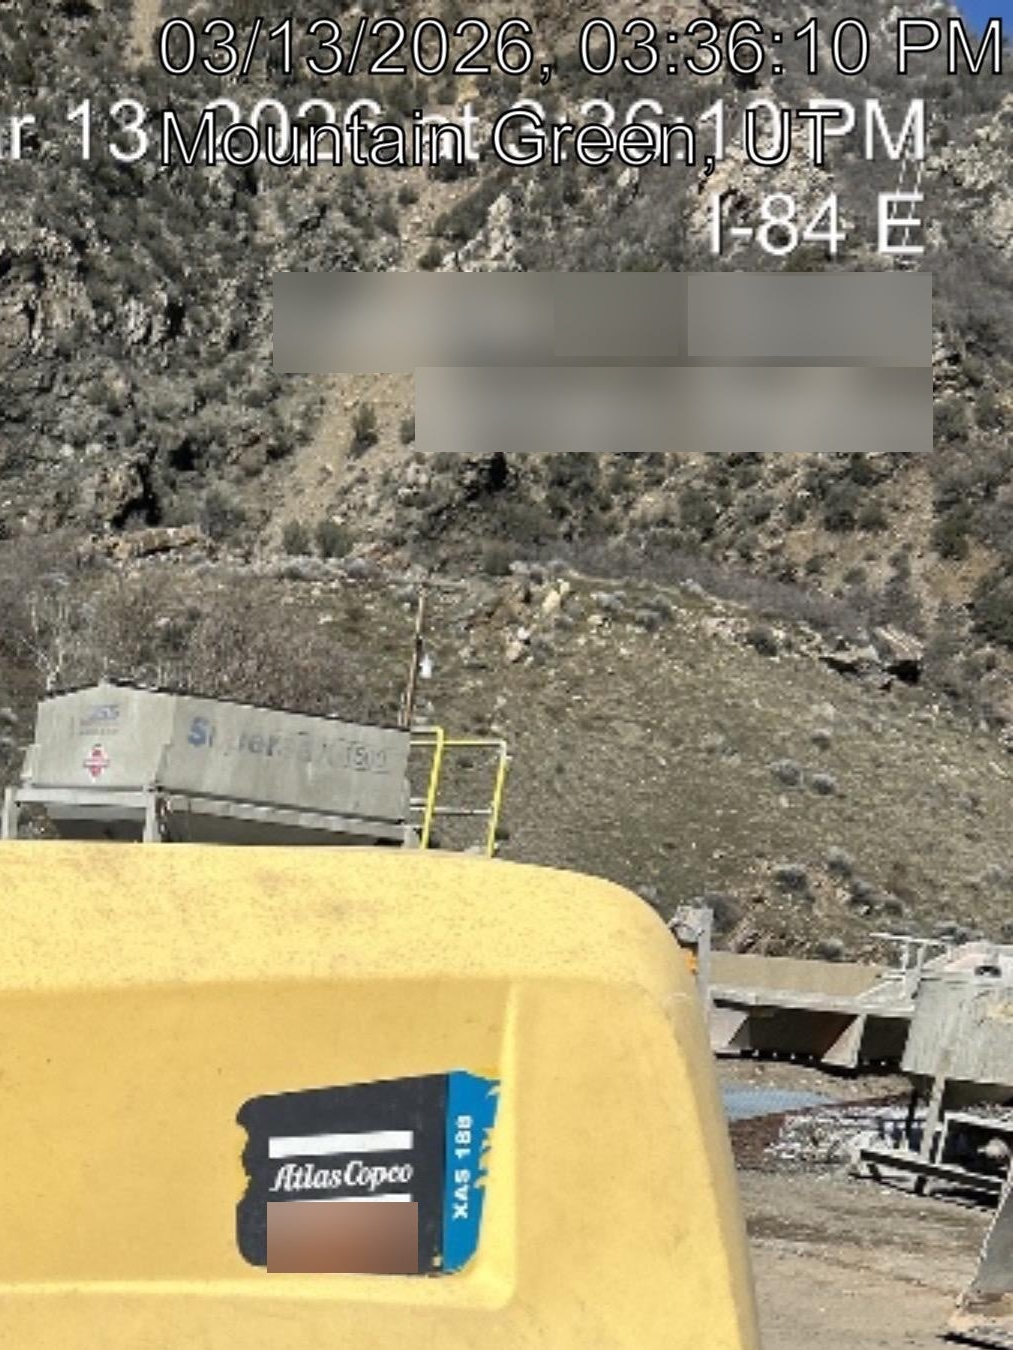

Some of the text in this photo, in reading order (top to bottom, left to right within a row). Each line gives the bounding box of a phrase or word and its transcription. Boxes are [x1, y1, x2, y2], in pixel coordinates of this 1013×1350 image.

[269, 1160, 414, 1192] Atlas Copco
[452, 1169, 471, 1220] XAS
